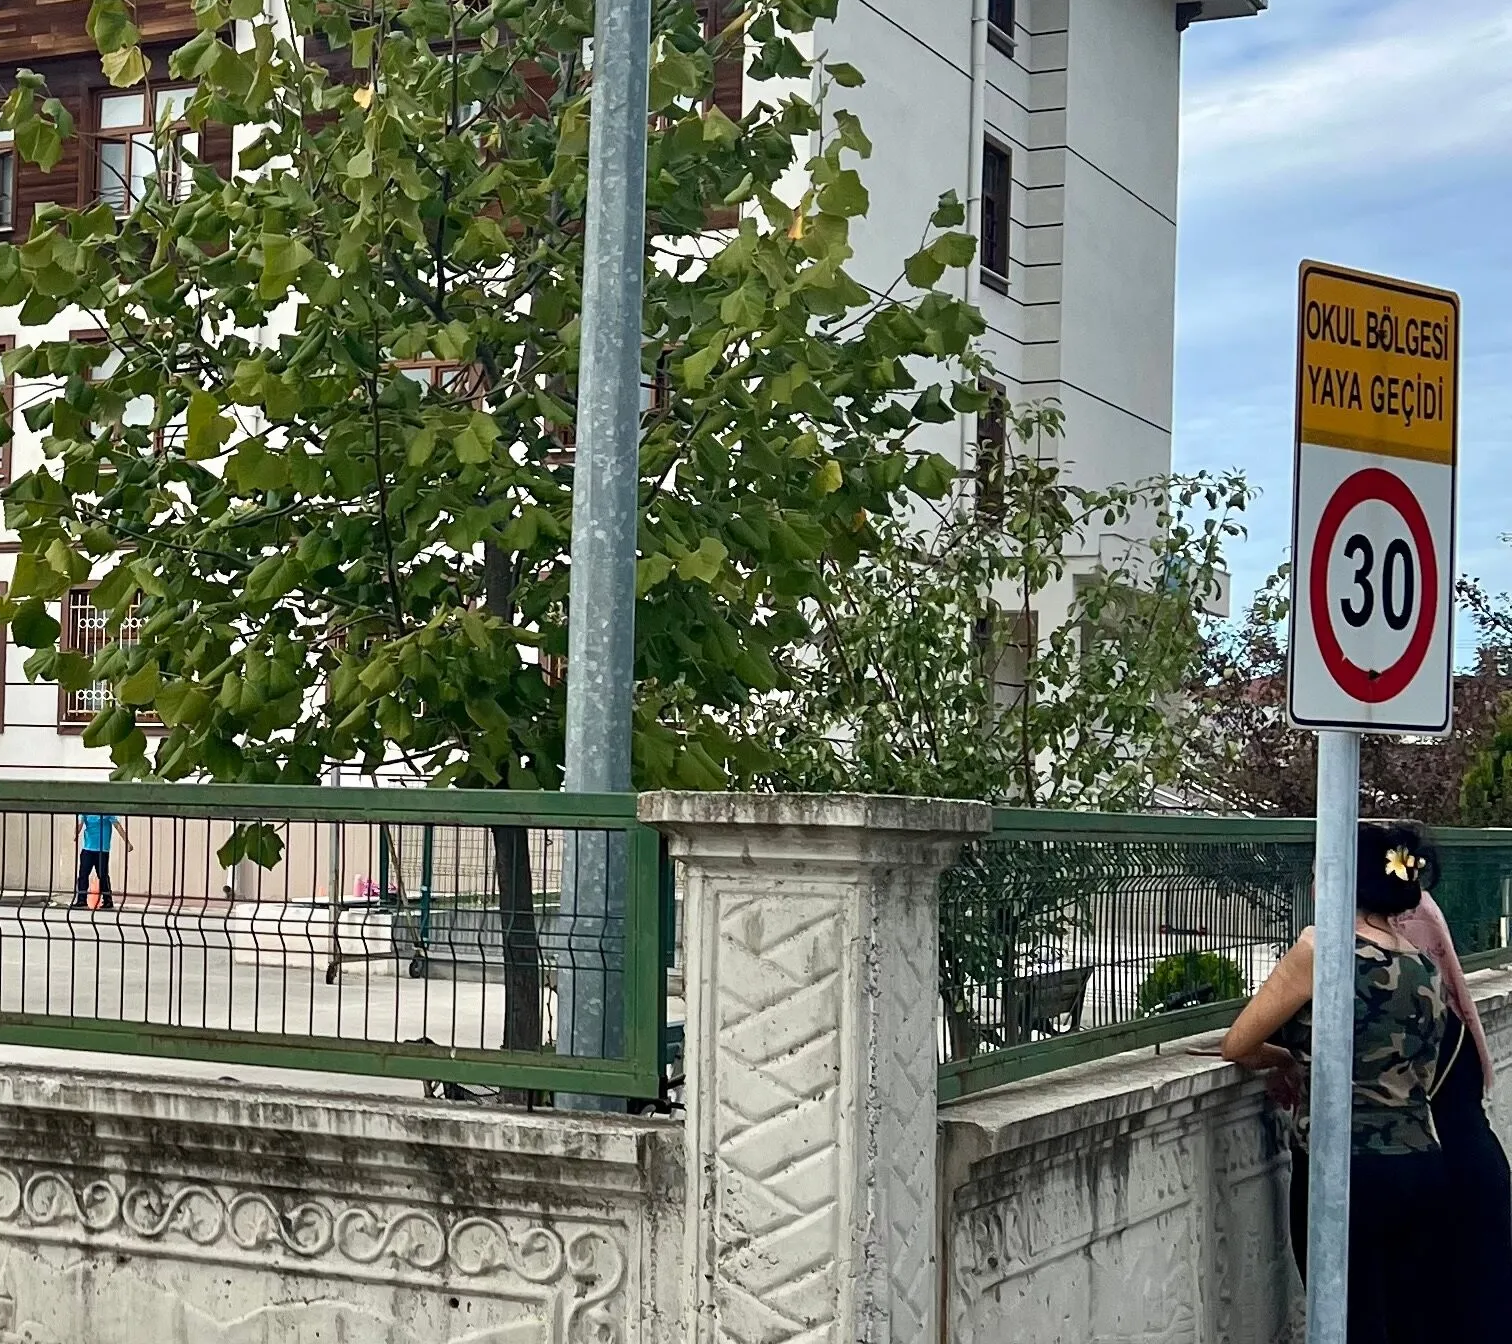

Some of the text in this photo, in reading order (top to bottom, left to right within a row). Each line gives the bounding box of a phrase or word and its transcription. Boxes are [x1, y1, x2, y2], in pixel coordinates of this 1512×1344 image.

[1306, 300, 1449, 361] OKUL BÖLGESİ
[1308, 364, 1443, 427] YAYA GEÇİDİ
[1340, 534, 1414, 630] 30
